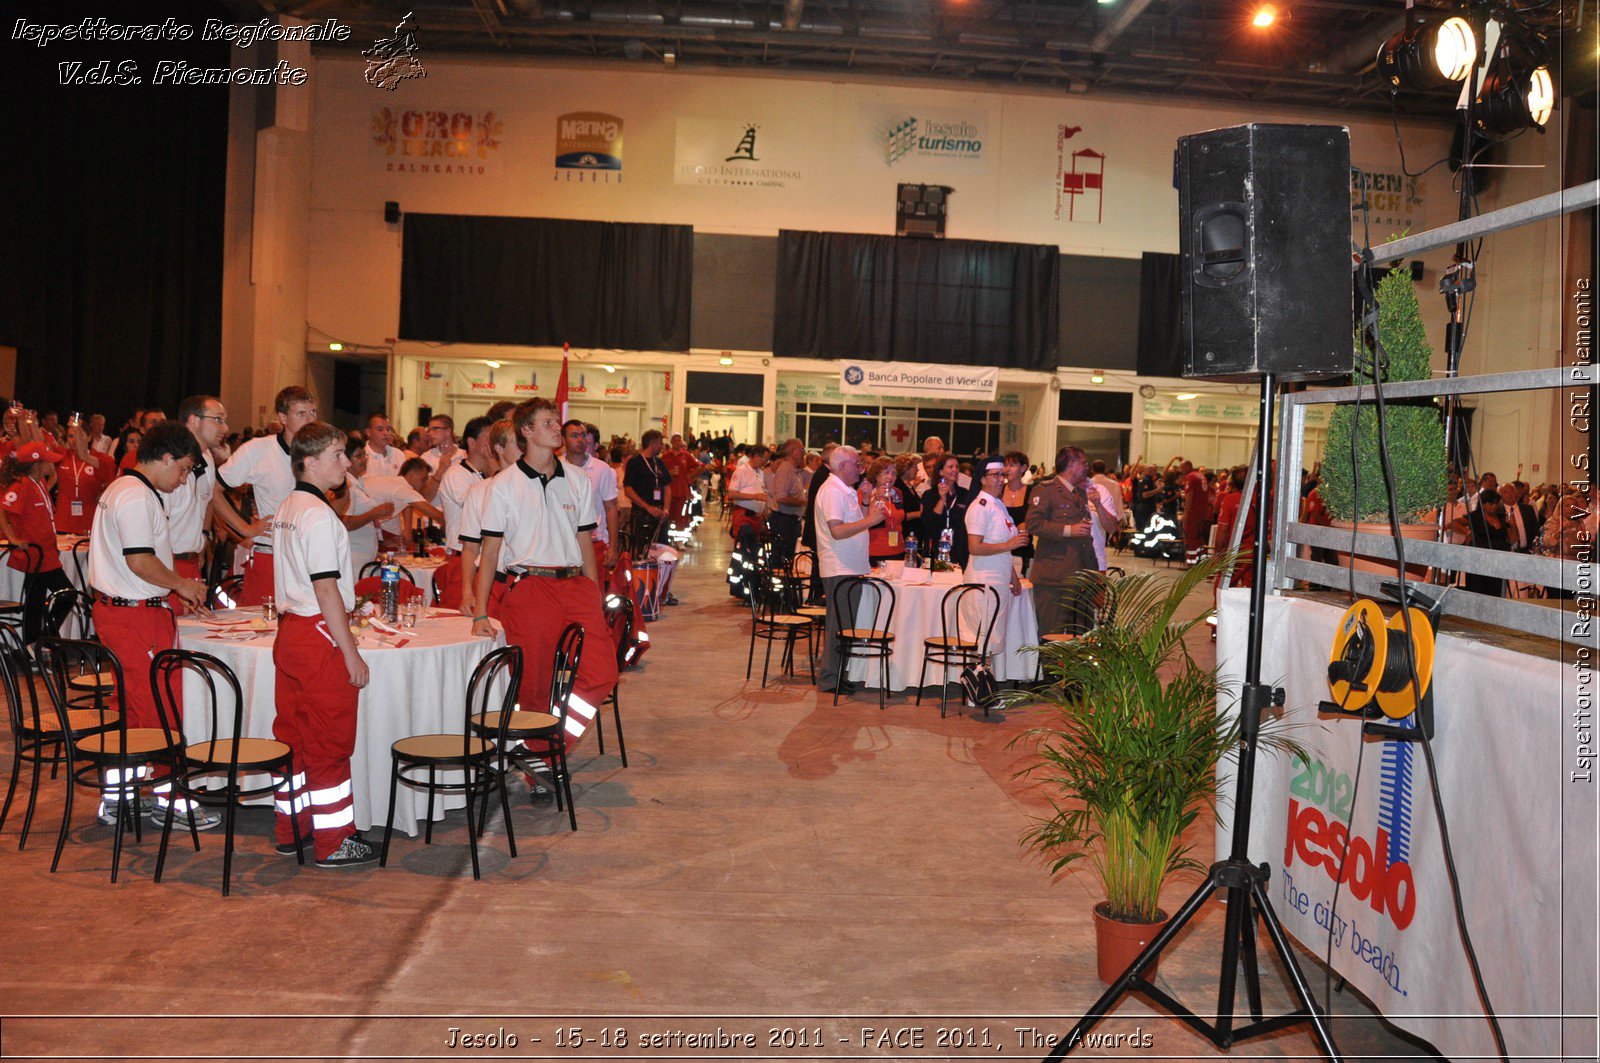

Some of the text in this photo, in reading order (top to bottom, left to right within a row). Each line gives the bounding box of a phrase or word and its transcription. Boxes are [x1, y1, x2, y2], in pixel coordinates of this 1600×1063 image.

[402, 110, 472, 139] ORO
[918, 137, 982, 152] turismo
[387, 163, 484, 174] BALNEARIO
[554, 171, 622, 183] JESOLO
[868, 371, 994, 387] Banca Popolare di Vicenza
[1290, 755, 1353, 823] 2012
[1282, 869, 1408, 997] The city beach.
